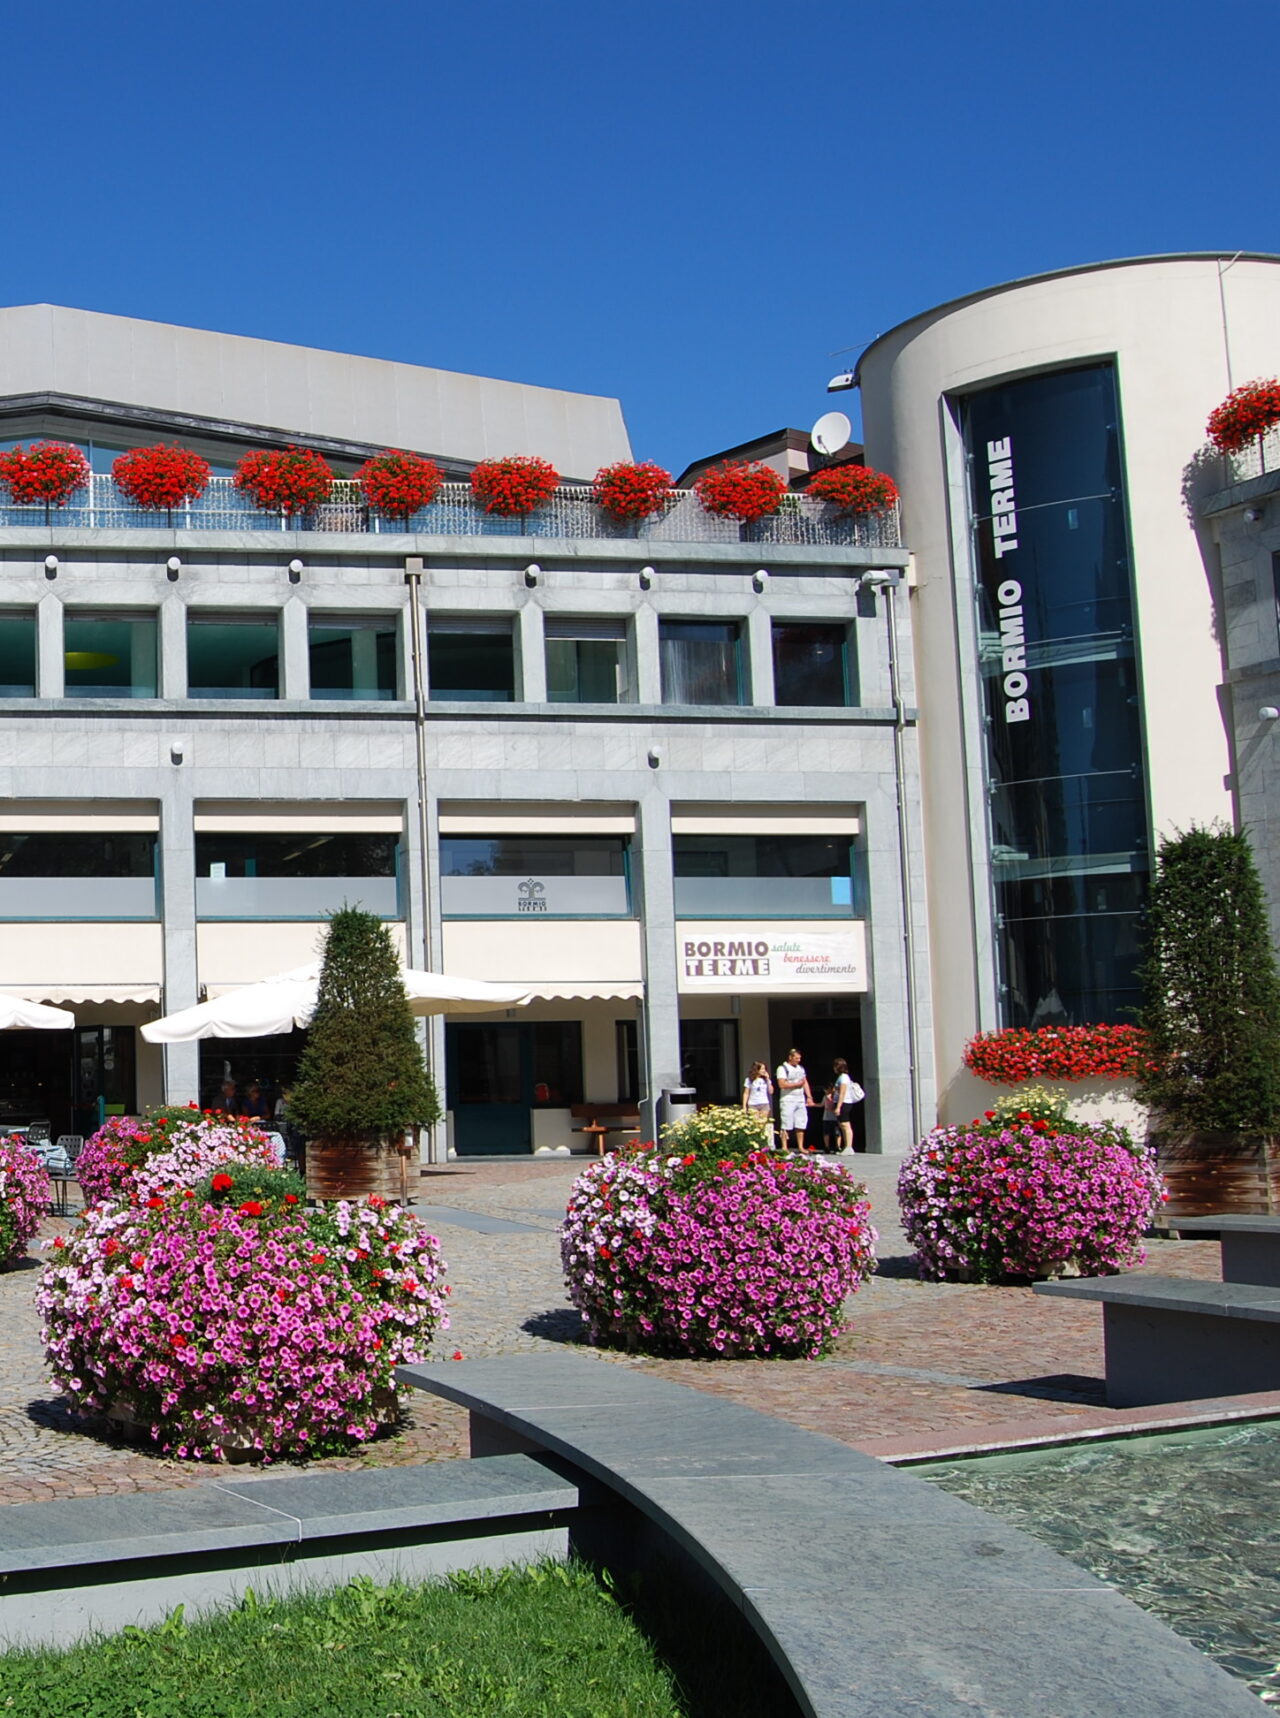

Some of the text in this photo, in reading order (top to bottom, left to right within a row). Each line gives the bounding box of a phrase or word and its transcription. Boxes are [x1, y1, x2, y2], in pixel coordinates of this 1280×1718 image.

[987, 436, 1030, 723] BORMIO TERME
[684, 941, 769, 957] BORMIO
[771, 942, 801, 952] salute
[783, 953, 831, 963] benessere
[686, 959, 770, 976] TERME
[796, 963, 857, 974] divertimento
